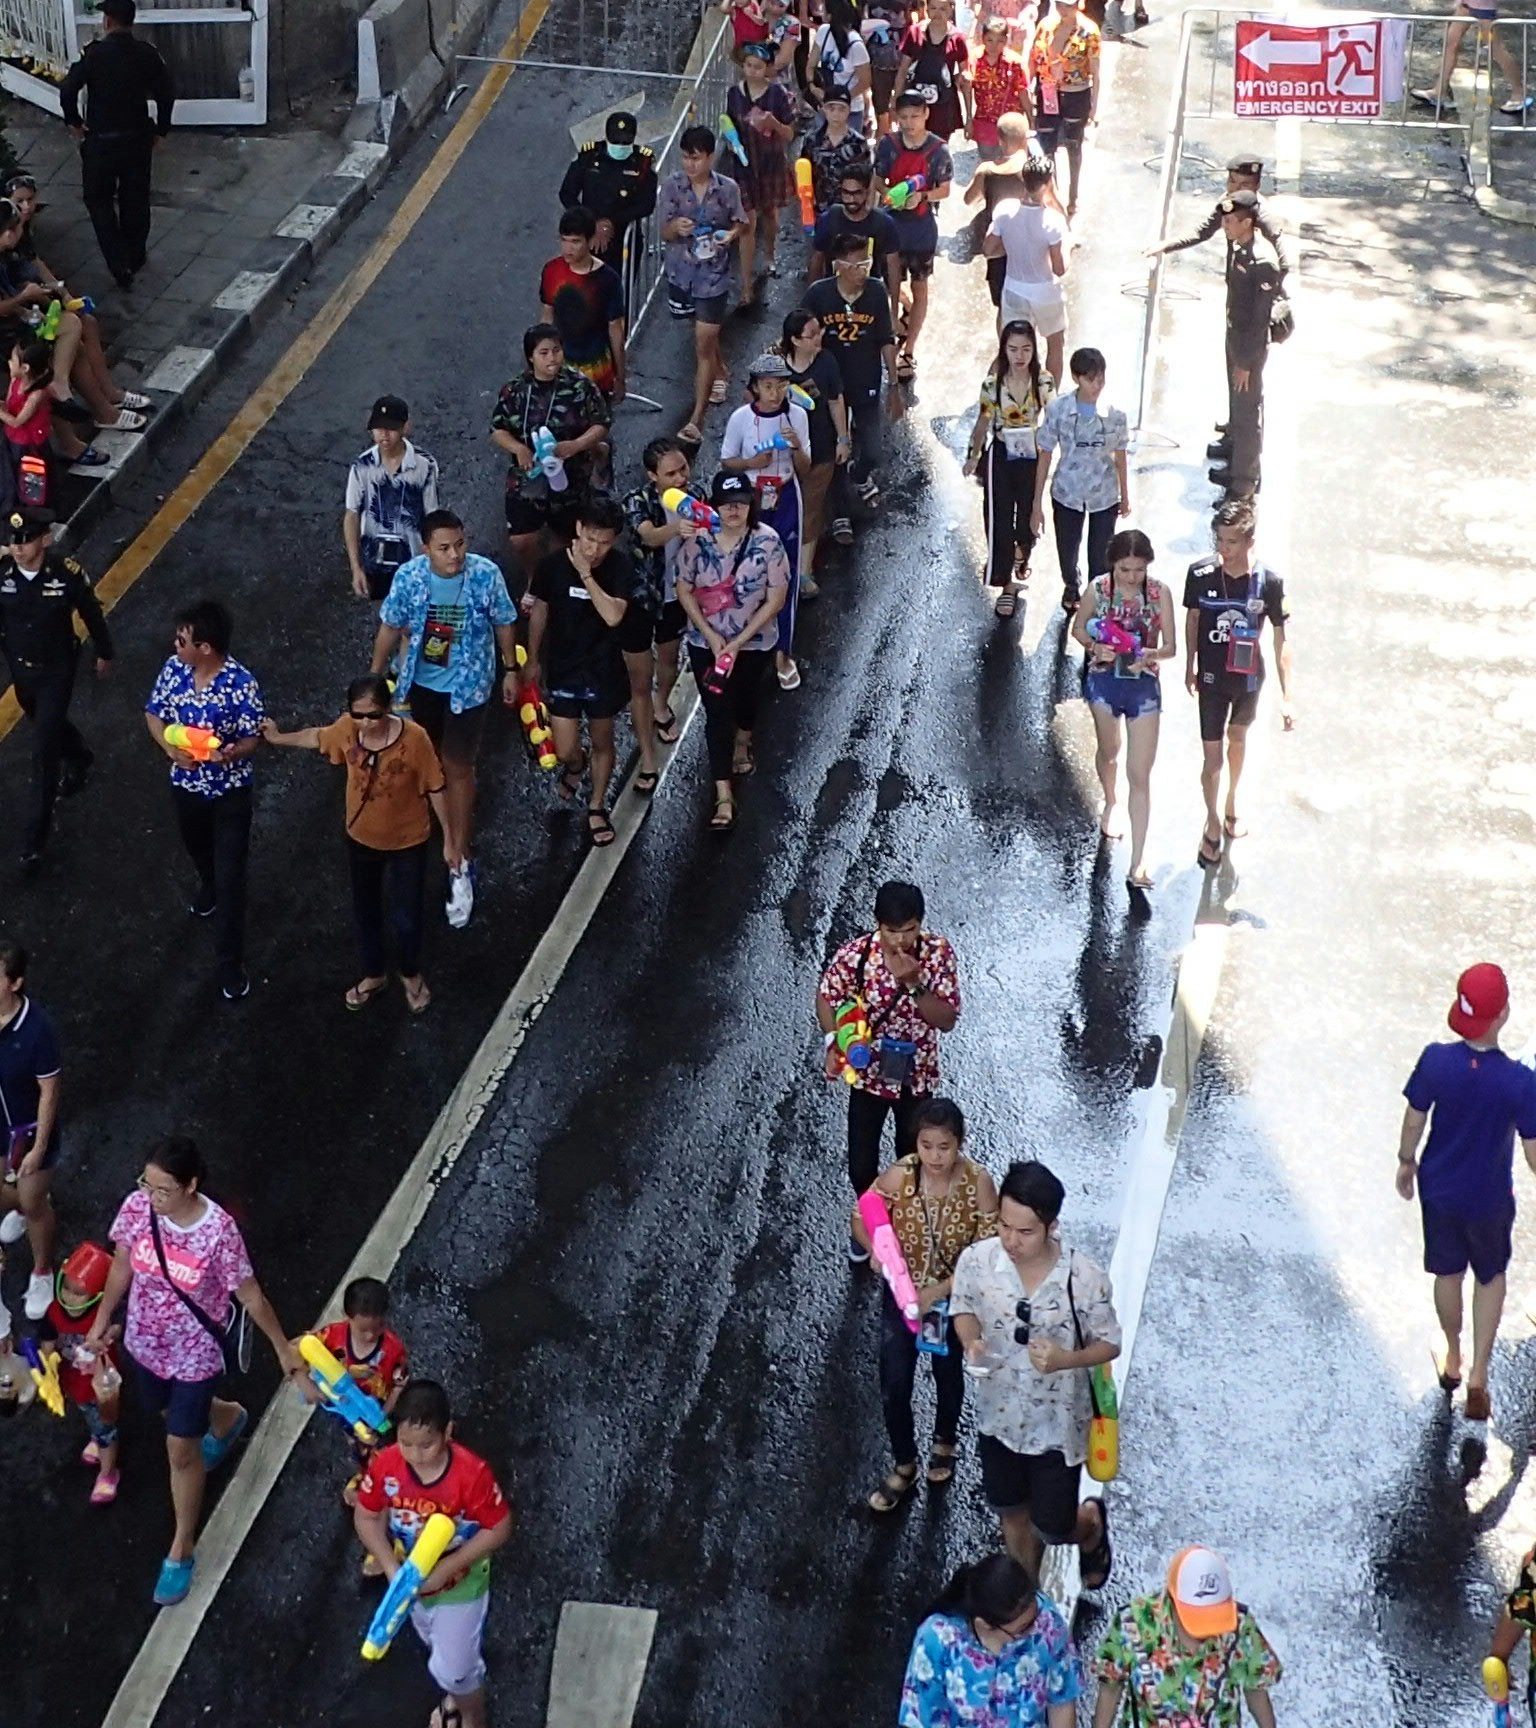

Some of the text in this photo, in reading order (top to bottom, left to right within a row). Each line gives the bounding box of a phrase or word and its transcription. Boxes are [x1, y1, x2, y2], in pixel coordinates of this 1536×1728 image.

[1236, 80, 1325, 97] ทางออก
[1236, 100, 1379, 115] EMERGENCY EXIT
[838, 323, 859, 341] 22
[135, 1238, 201, 1285] Supeme
